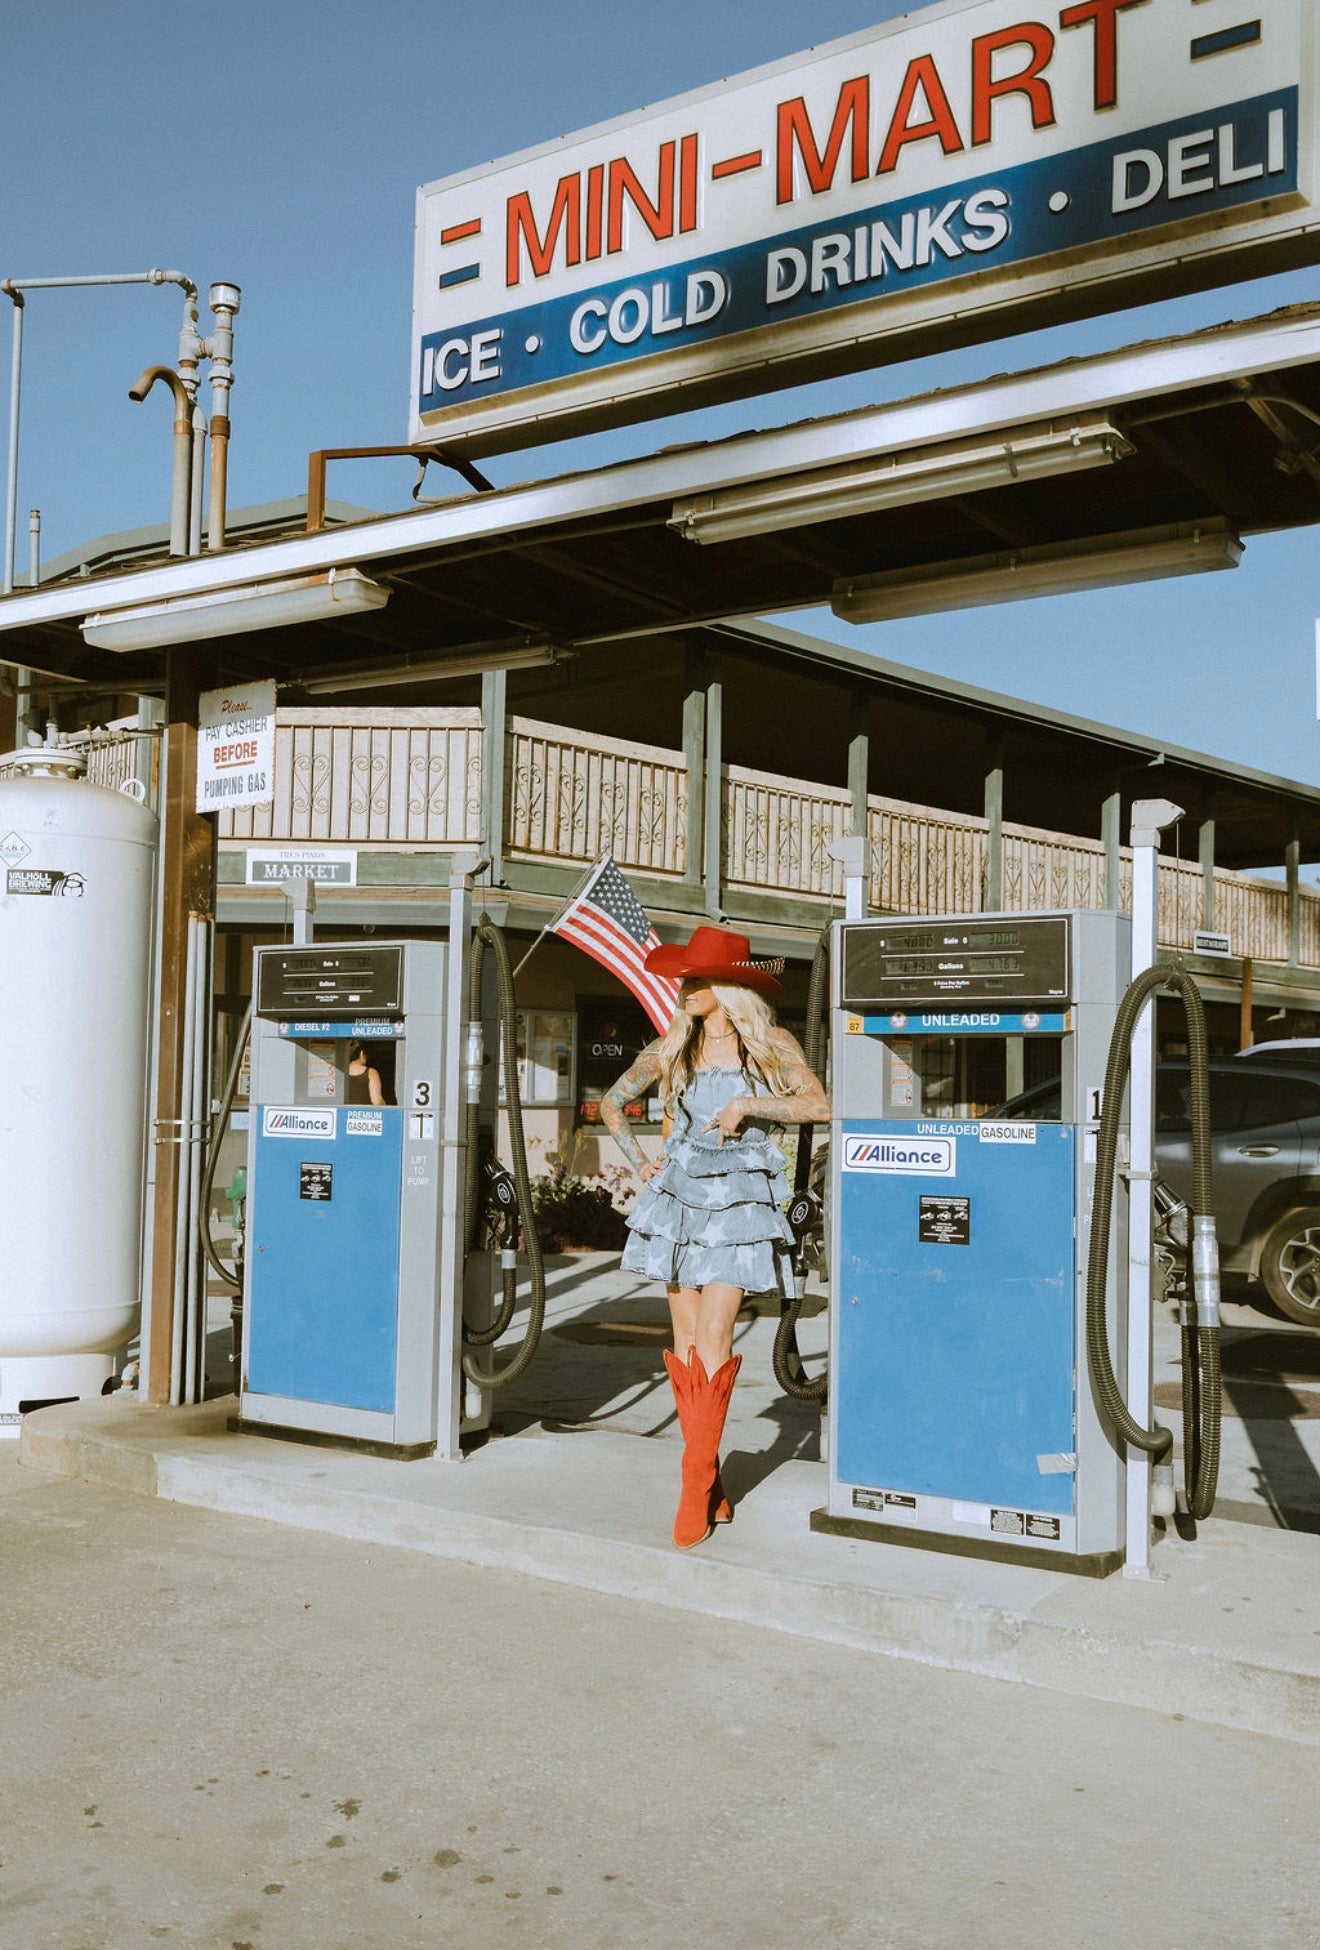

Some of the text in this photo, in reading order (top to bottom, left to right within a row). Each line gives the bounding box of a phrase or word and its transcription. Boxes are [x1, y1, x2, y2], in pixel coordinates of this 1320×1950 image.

[505, 0, 1150, 288] MINI-MART
[421, 107, 1285, 397] ICE COLD DRINKS DELI
[205, 716, 268, 741] PAY CASHIER
[213, 741, 258, 763] BEFORE
[204, 772, 267, 799] PUMPING GAS
[263, 863, 340, 880] MARKET
[8, 879, 52, 889] BREWING
[294, 1023, 320, 1031] DIESEL
[355, 1017, 390, 1026] PREMIUM
[922, 1013, 1000, 1027] UNLEADED
[351, 1026, 393, 1035] UNLEADED
[592, 1043, 623, 1056] OPEN
[415, 1082, 430, 1106] 3
[278, 1114, 328, 1130] Alliance
[347, 1111, 382, 1120] PREMIUM
[347, 1121, 382, 1132] GASOLINE
[917, 1123, 1035, 1140] UNLEADED GASOLINE
[865, 1144, 943, 1164] Alliance
